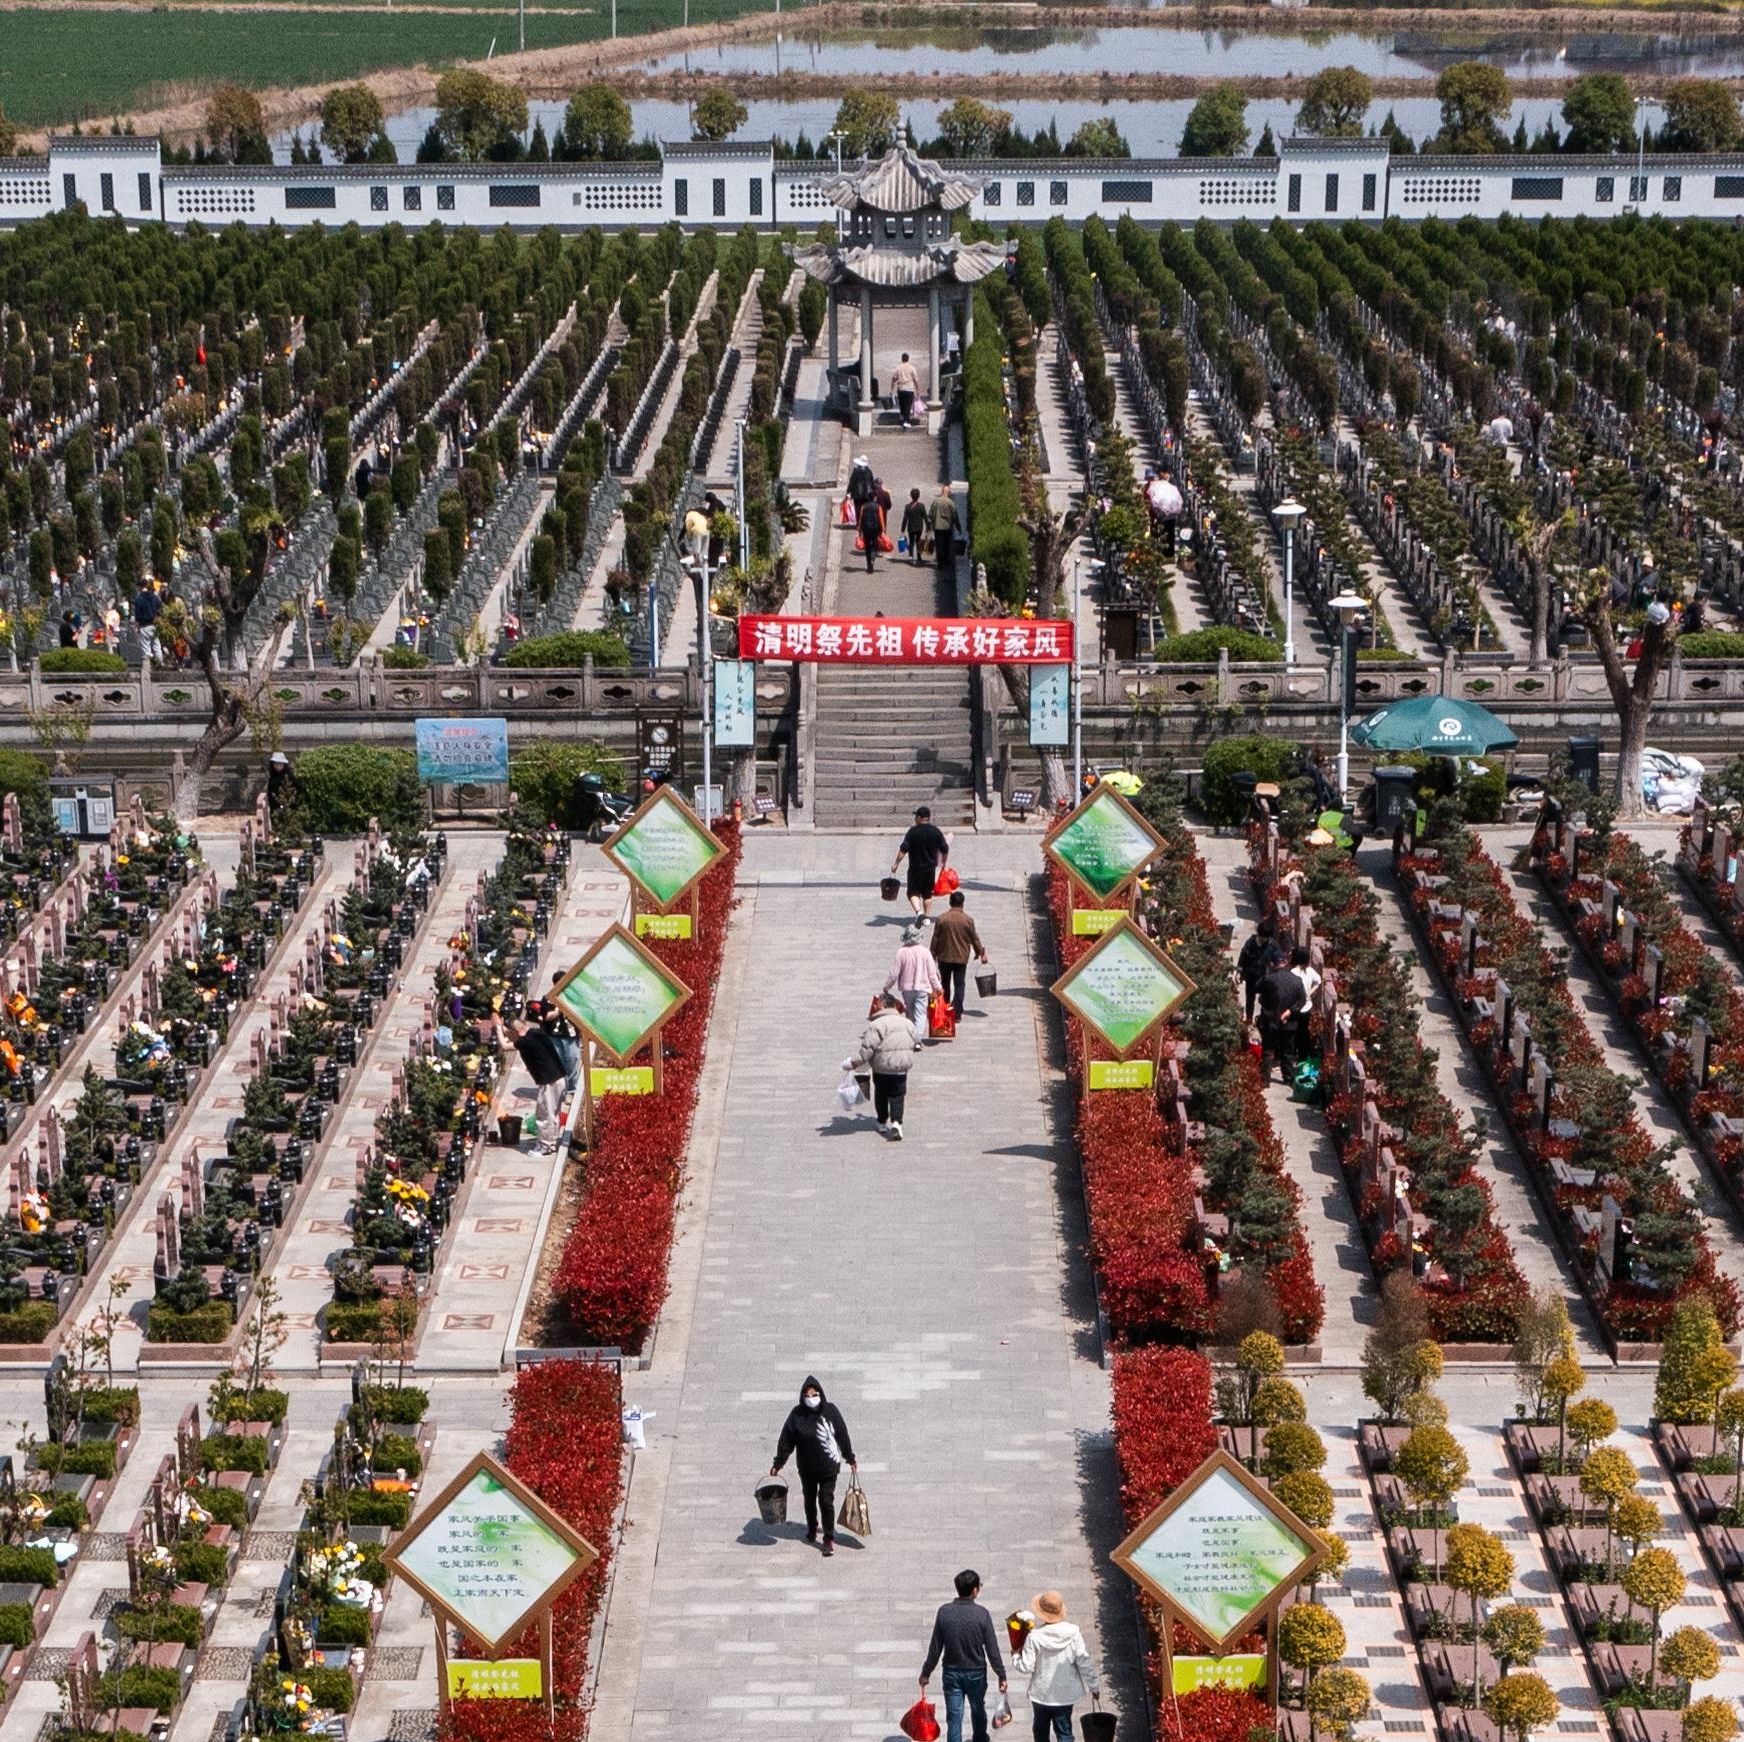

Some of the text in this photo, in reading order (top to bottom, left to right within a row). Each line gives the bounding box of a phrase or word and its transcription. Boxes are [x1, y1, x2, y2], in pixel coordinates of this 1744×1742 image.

[755, 622, 1060, 658] 清明祭先祖 传承好家风
